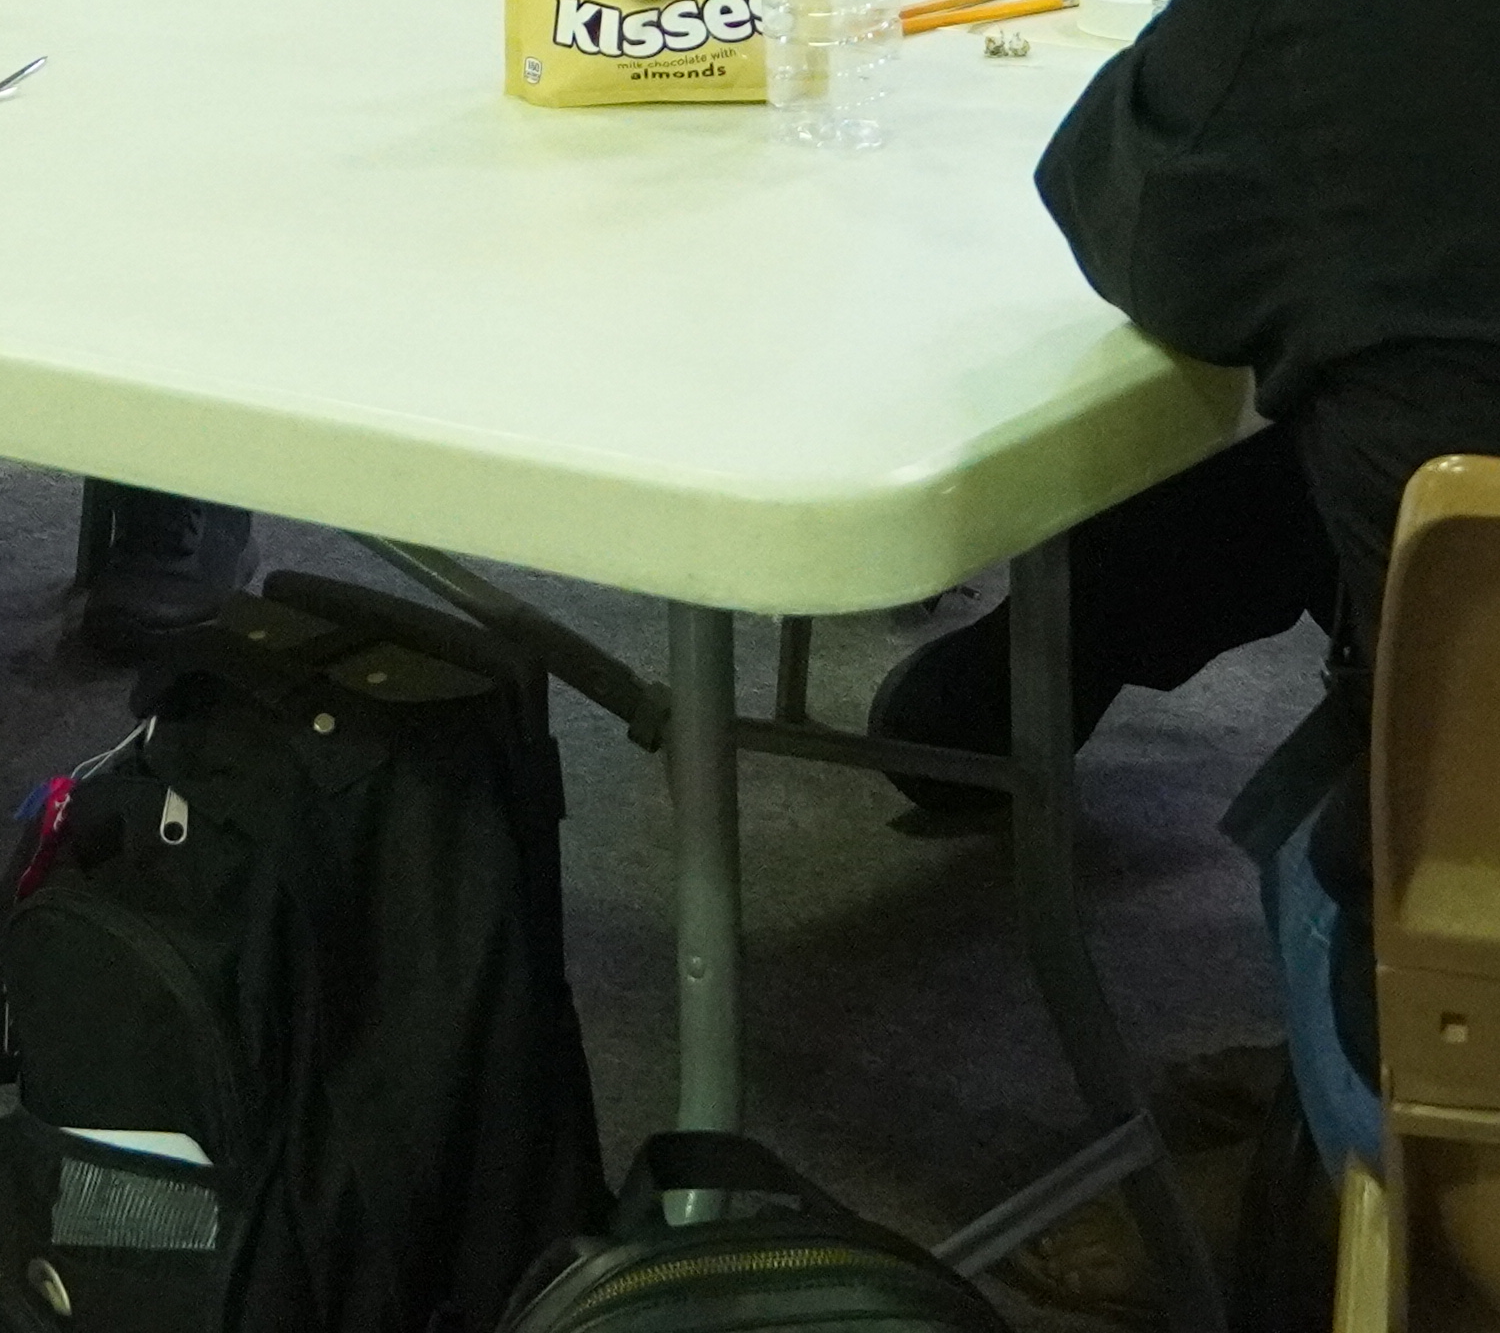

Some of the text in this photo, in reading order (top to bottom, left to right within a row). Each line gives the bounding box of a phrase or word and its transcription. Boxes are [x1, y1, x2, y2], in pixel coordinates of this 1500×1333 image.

[646, 53, 708, 68] chocolate
[710, 48, 738, 63] with
[630, 63, 728, 81] almonds
